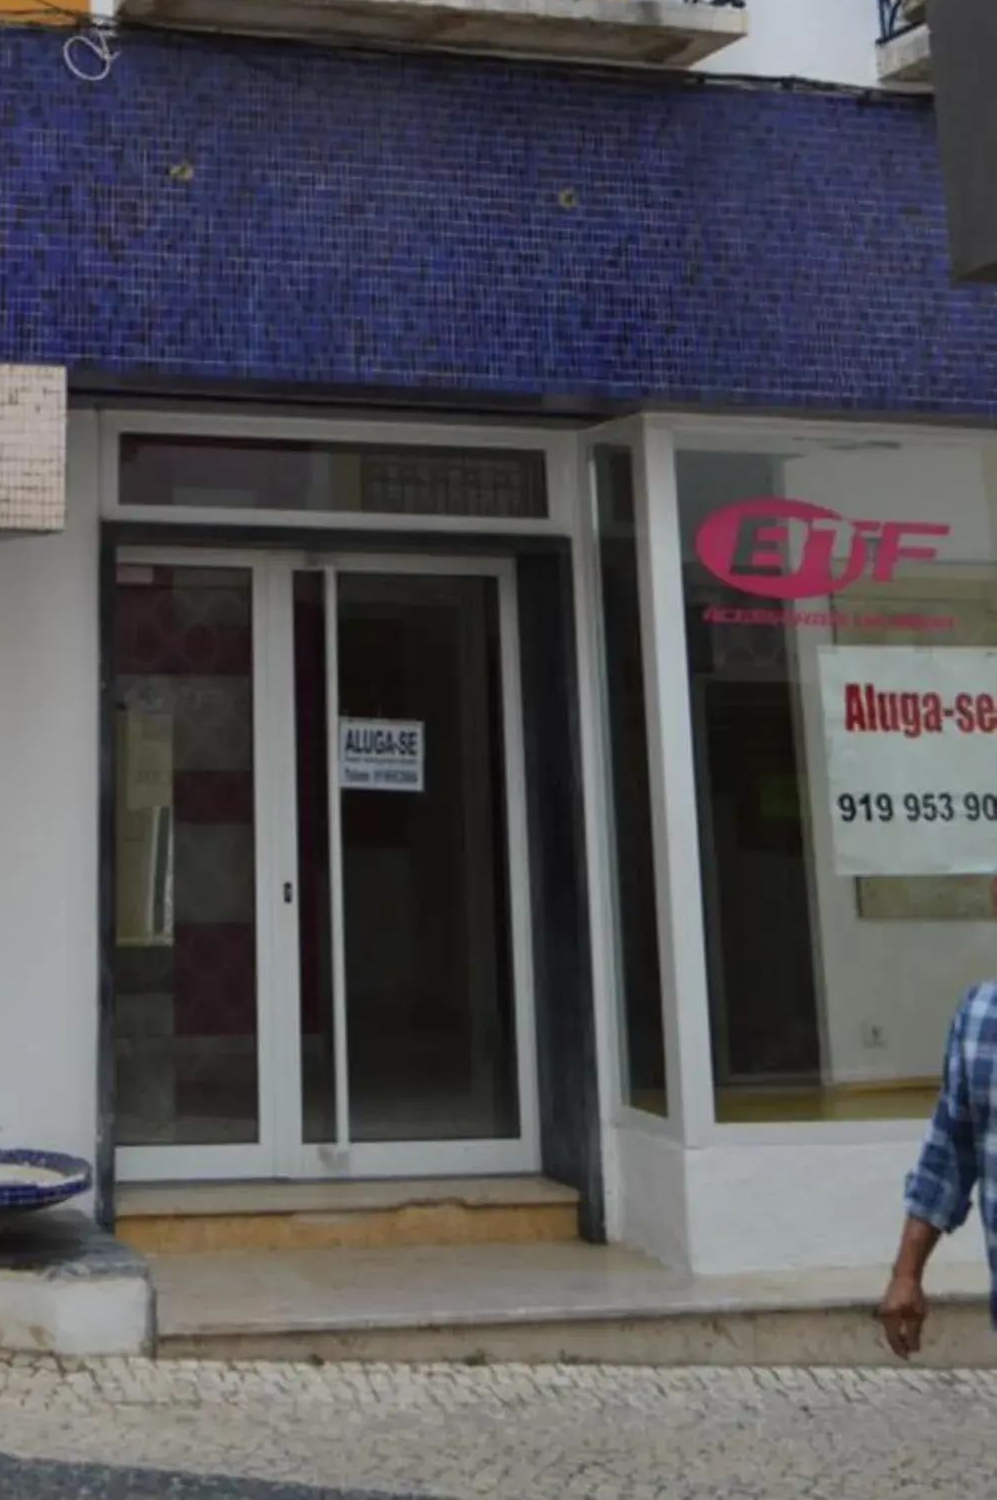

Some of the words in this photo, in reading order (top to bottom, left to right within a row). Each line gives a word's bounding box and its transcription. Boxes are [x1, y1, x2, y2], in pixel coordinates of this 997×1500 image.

[844, 682, 997, 738] Aluga-se
[345, 728, 418, 756] ALUGA-SE
[837, 792, 894, 823] 919
[902, 792, 954, 822] 953
